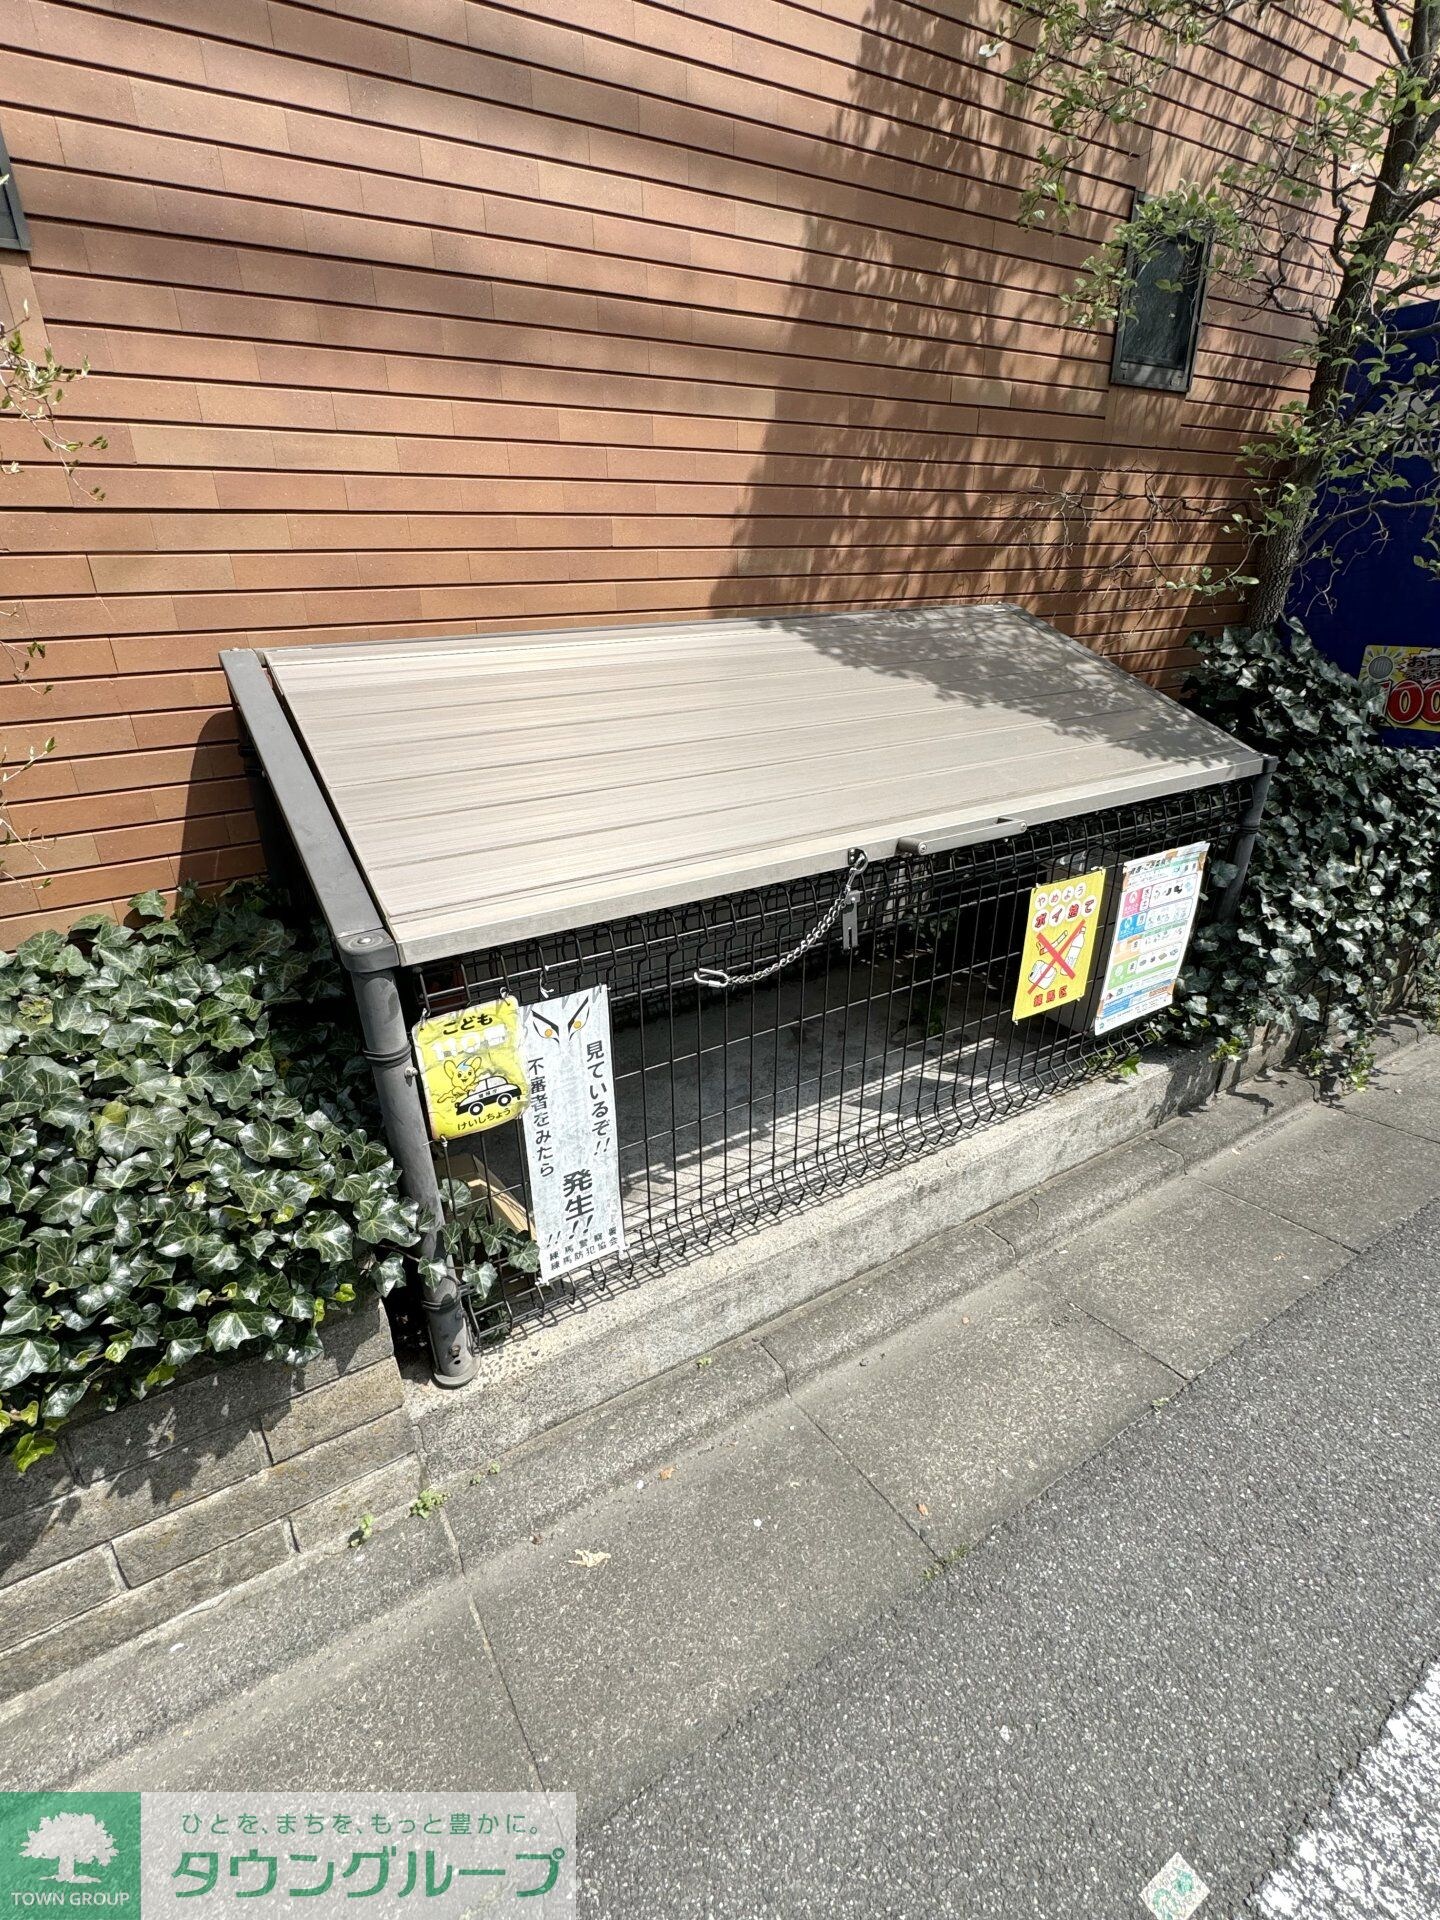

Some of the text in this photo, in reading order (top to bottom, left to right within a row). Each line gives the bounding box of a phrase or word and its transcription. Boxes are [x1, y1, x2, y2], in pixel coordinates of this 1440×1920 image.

[1038, 886, 1083, 906] やめよう
[1034, 899, 1094, 928] ポイ捨て
[443, 1013, 493, 1035] こども
[457, 1108, 511, 1130] けいしちょう
[527, 1057, 555, 1177] 不審者をみたら
[549, 1226, 617, 1261] 練馬警察署
[550, 1237, 618, 1270] 練馬防犯協会
